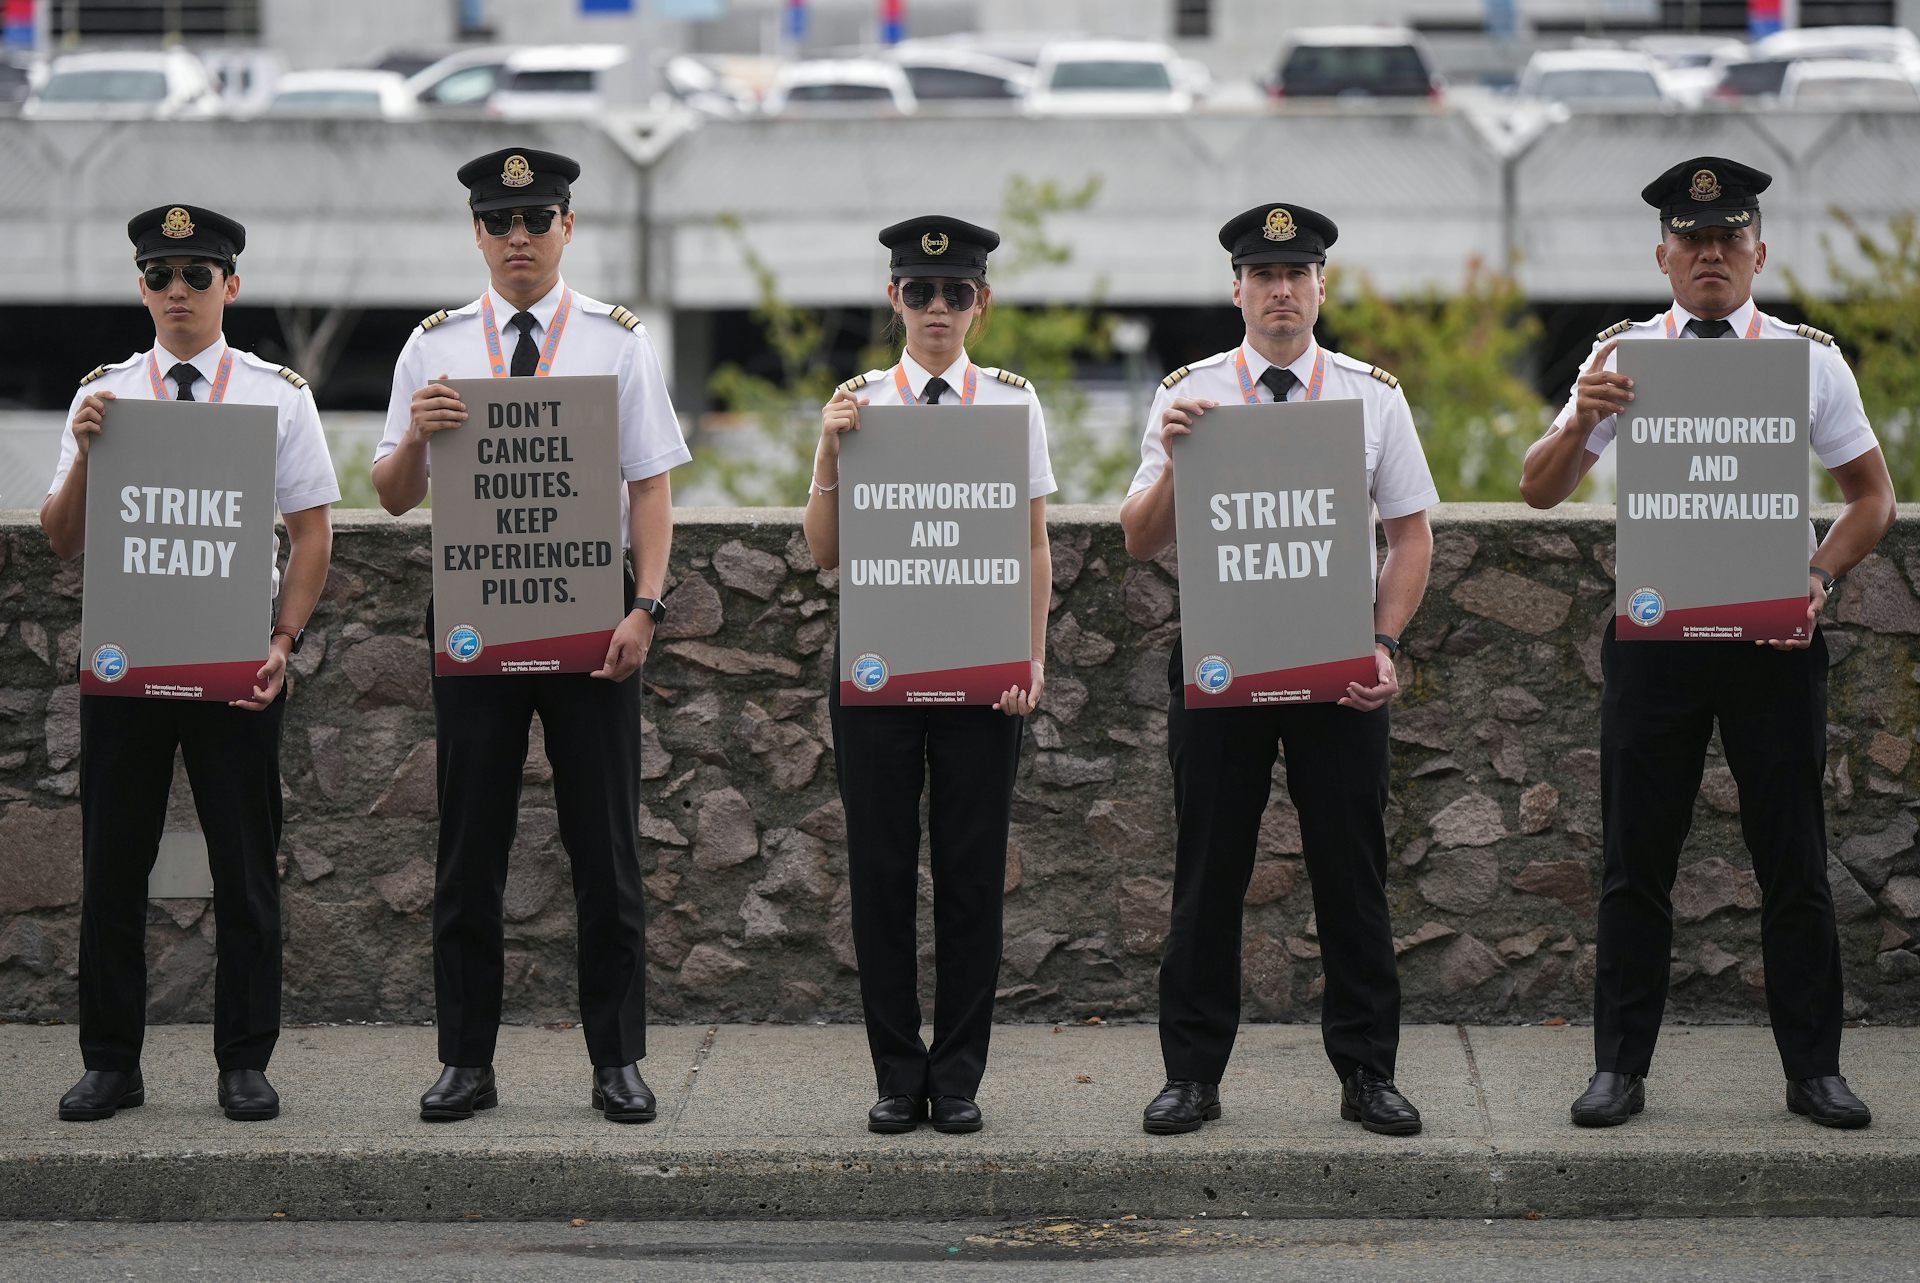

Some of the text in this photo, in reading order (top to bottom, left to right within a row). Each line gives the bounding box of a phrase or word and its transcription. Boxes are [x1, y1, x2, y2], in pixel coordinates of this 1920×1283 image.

[487, 401, 562, 429] DON'T
[1631, 416, 1796, 444] OVERWORKED
[478, 437, 573, 464] CANCEL
[1688, 455, 1738, 482] AND
[474, 471, 579, 500] ROUTES.
[853, 482, 1017, 510] OVERWORKED
[120, 485, 243, 528] STRIKE
[1209, 488, 1337, 532] STRIKE
[1628, 493, 1799, 520] UNDERVALUED
[496, 507, 558, 535] KEEP
[910, 520, 960, 548] AND
[123, 536, 237, 578] READY
[443, 540, 612, 571] EXPERIENCED
[1217, 539, 1333, 582] READY
[851, 558, 1020, 586] UNDERVALUED
[482, 577, 576, 605] PILOTS.
